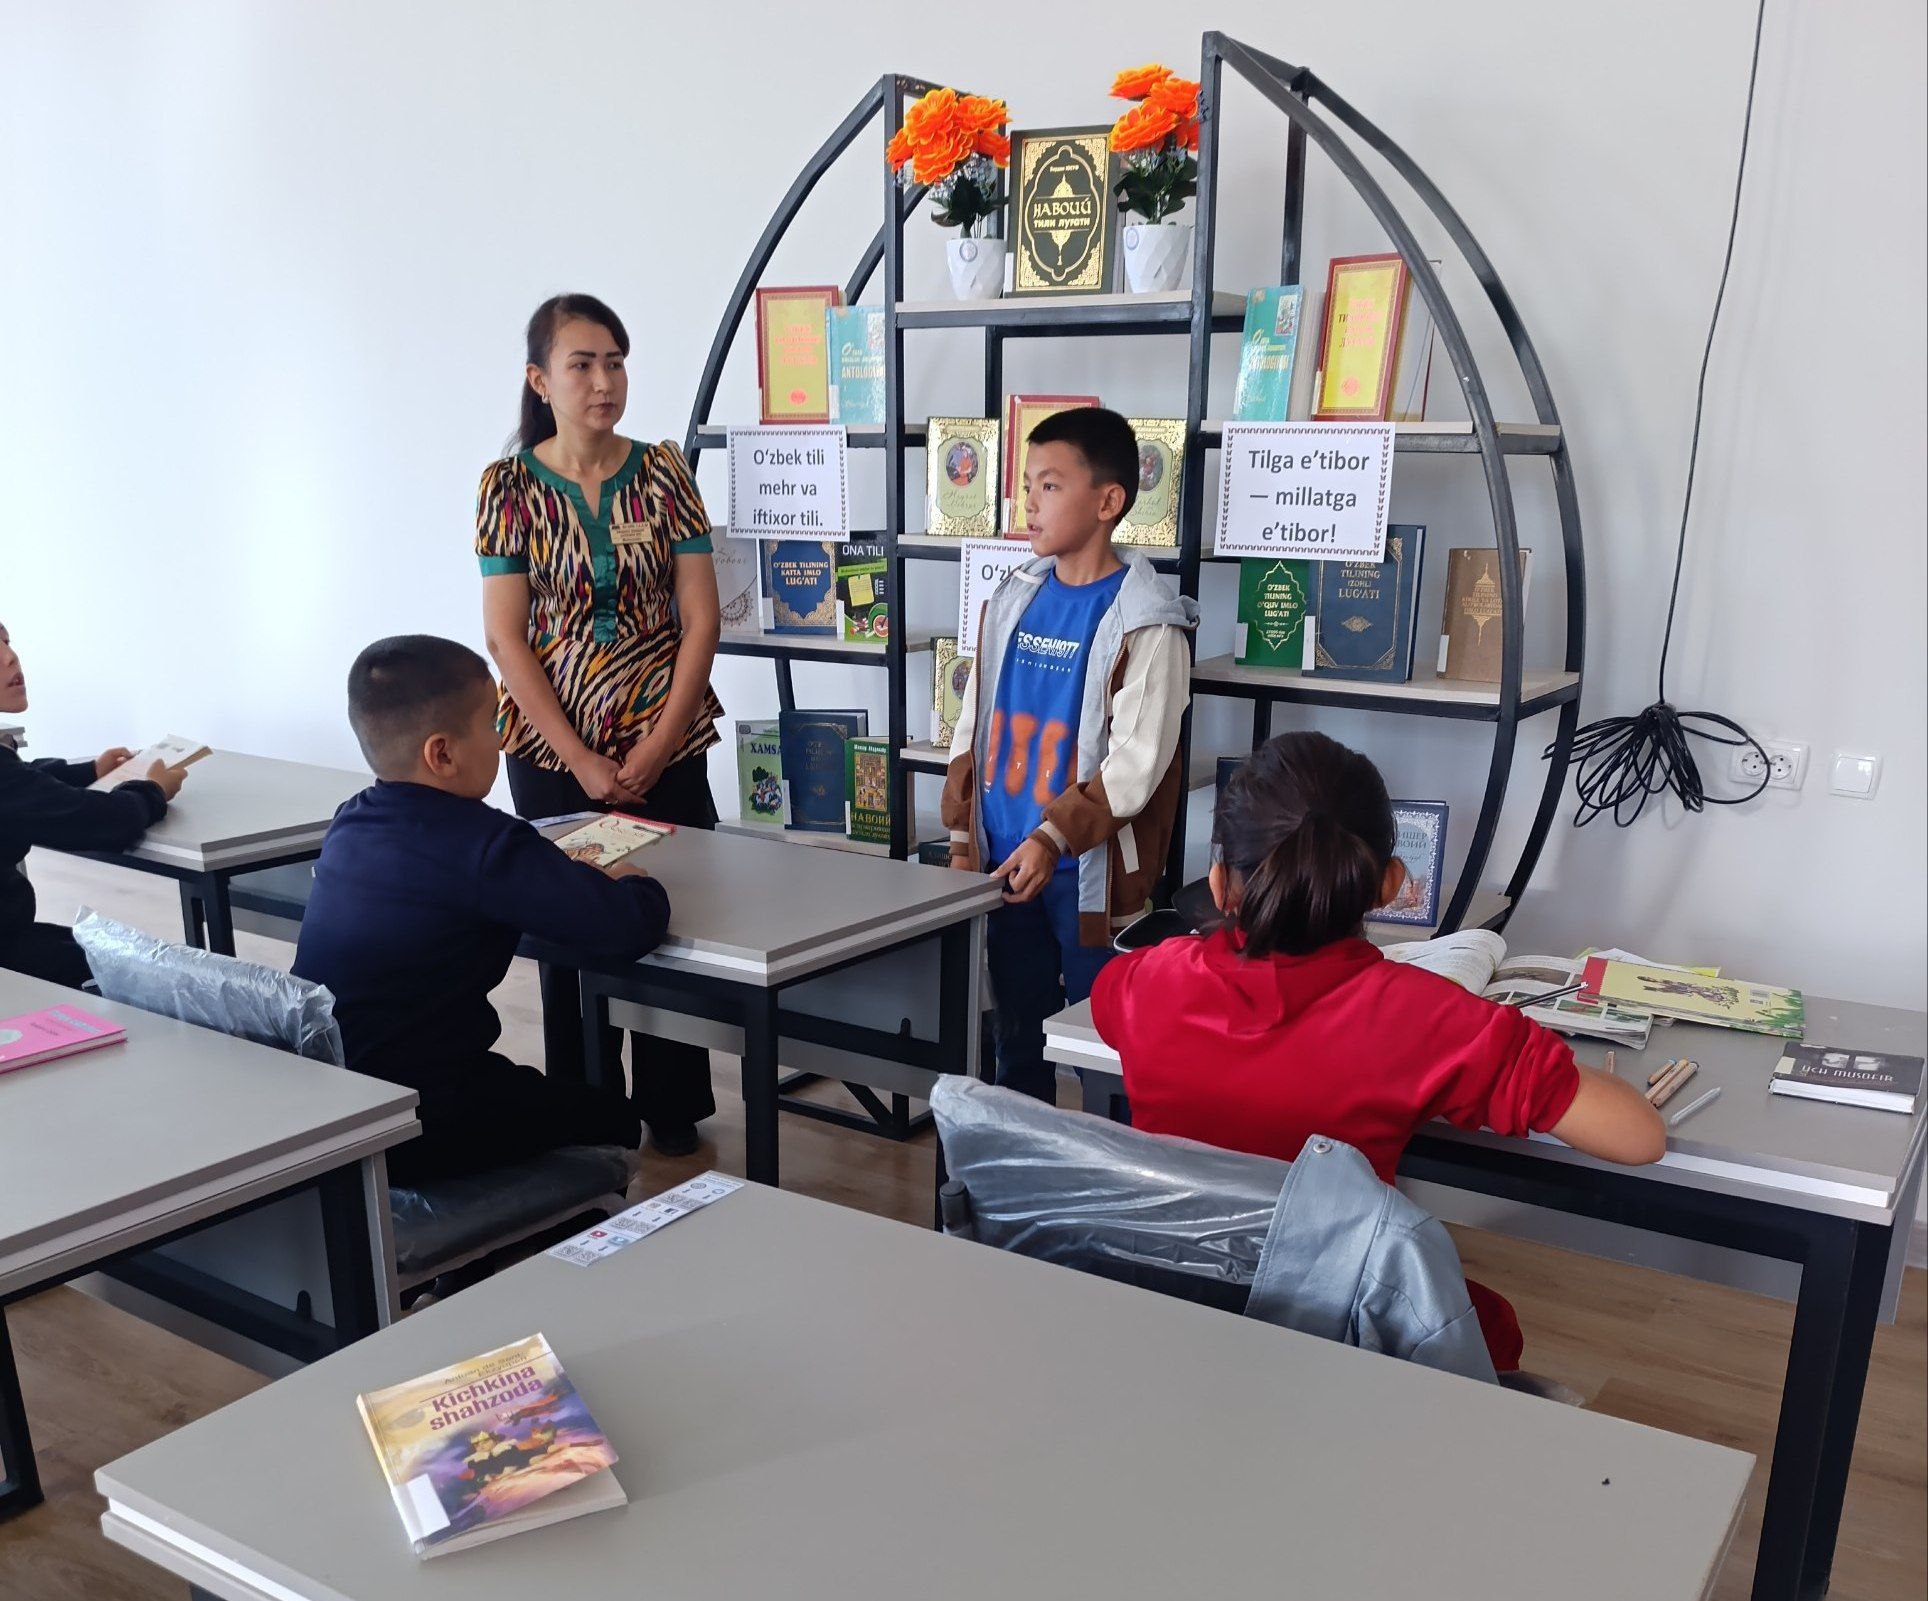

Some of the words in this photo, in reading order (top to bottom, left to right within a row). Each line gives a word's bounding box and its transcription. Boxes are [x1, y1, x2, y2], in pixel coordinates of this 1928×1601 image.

[753, 448, 802, 466] O‘zbek
[806, 449, 825, 466] tili
[1249, 450, 1294, 473] Tilga
[1300, 449, 1370, 471] e’tibor
[759, 479, 796, 496] mehr
[800, 483, 817, 496] va
[1275, 486, 1357, 512] millatga
[753, 508, 796, 526] iftixor
[800, 509, 823, 527] tili.
[1262, 522, 1337, 543] e’tibor!
[842, 544, 865, 556] ONA
[866, 545, 884, 557] TILI
[1340, 569, 1381, 579] TILINING
[432, 1366, 536, 1412] Kichkina
[429, 1379, 544, 1431] shahzoda
